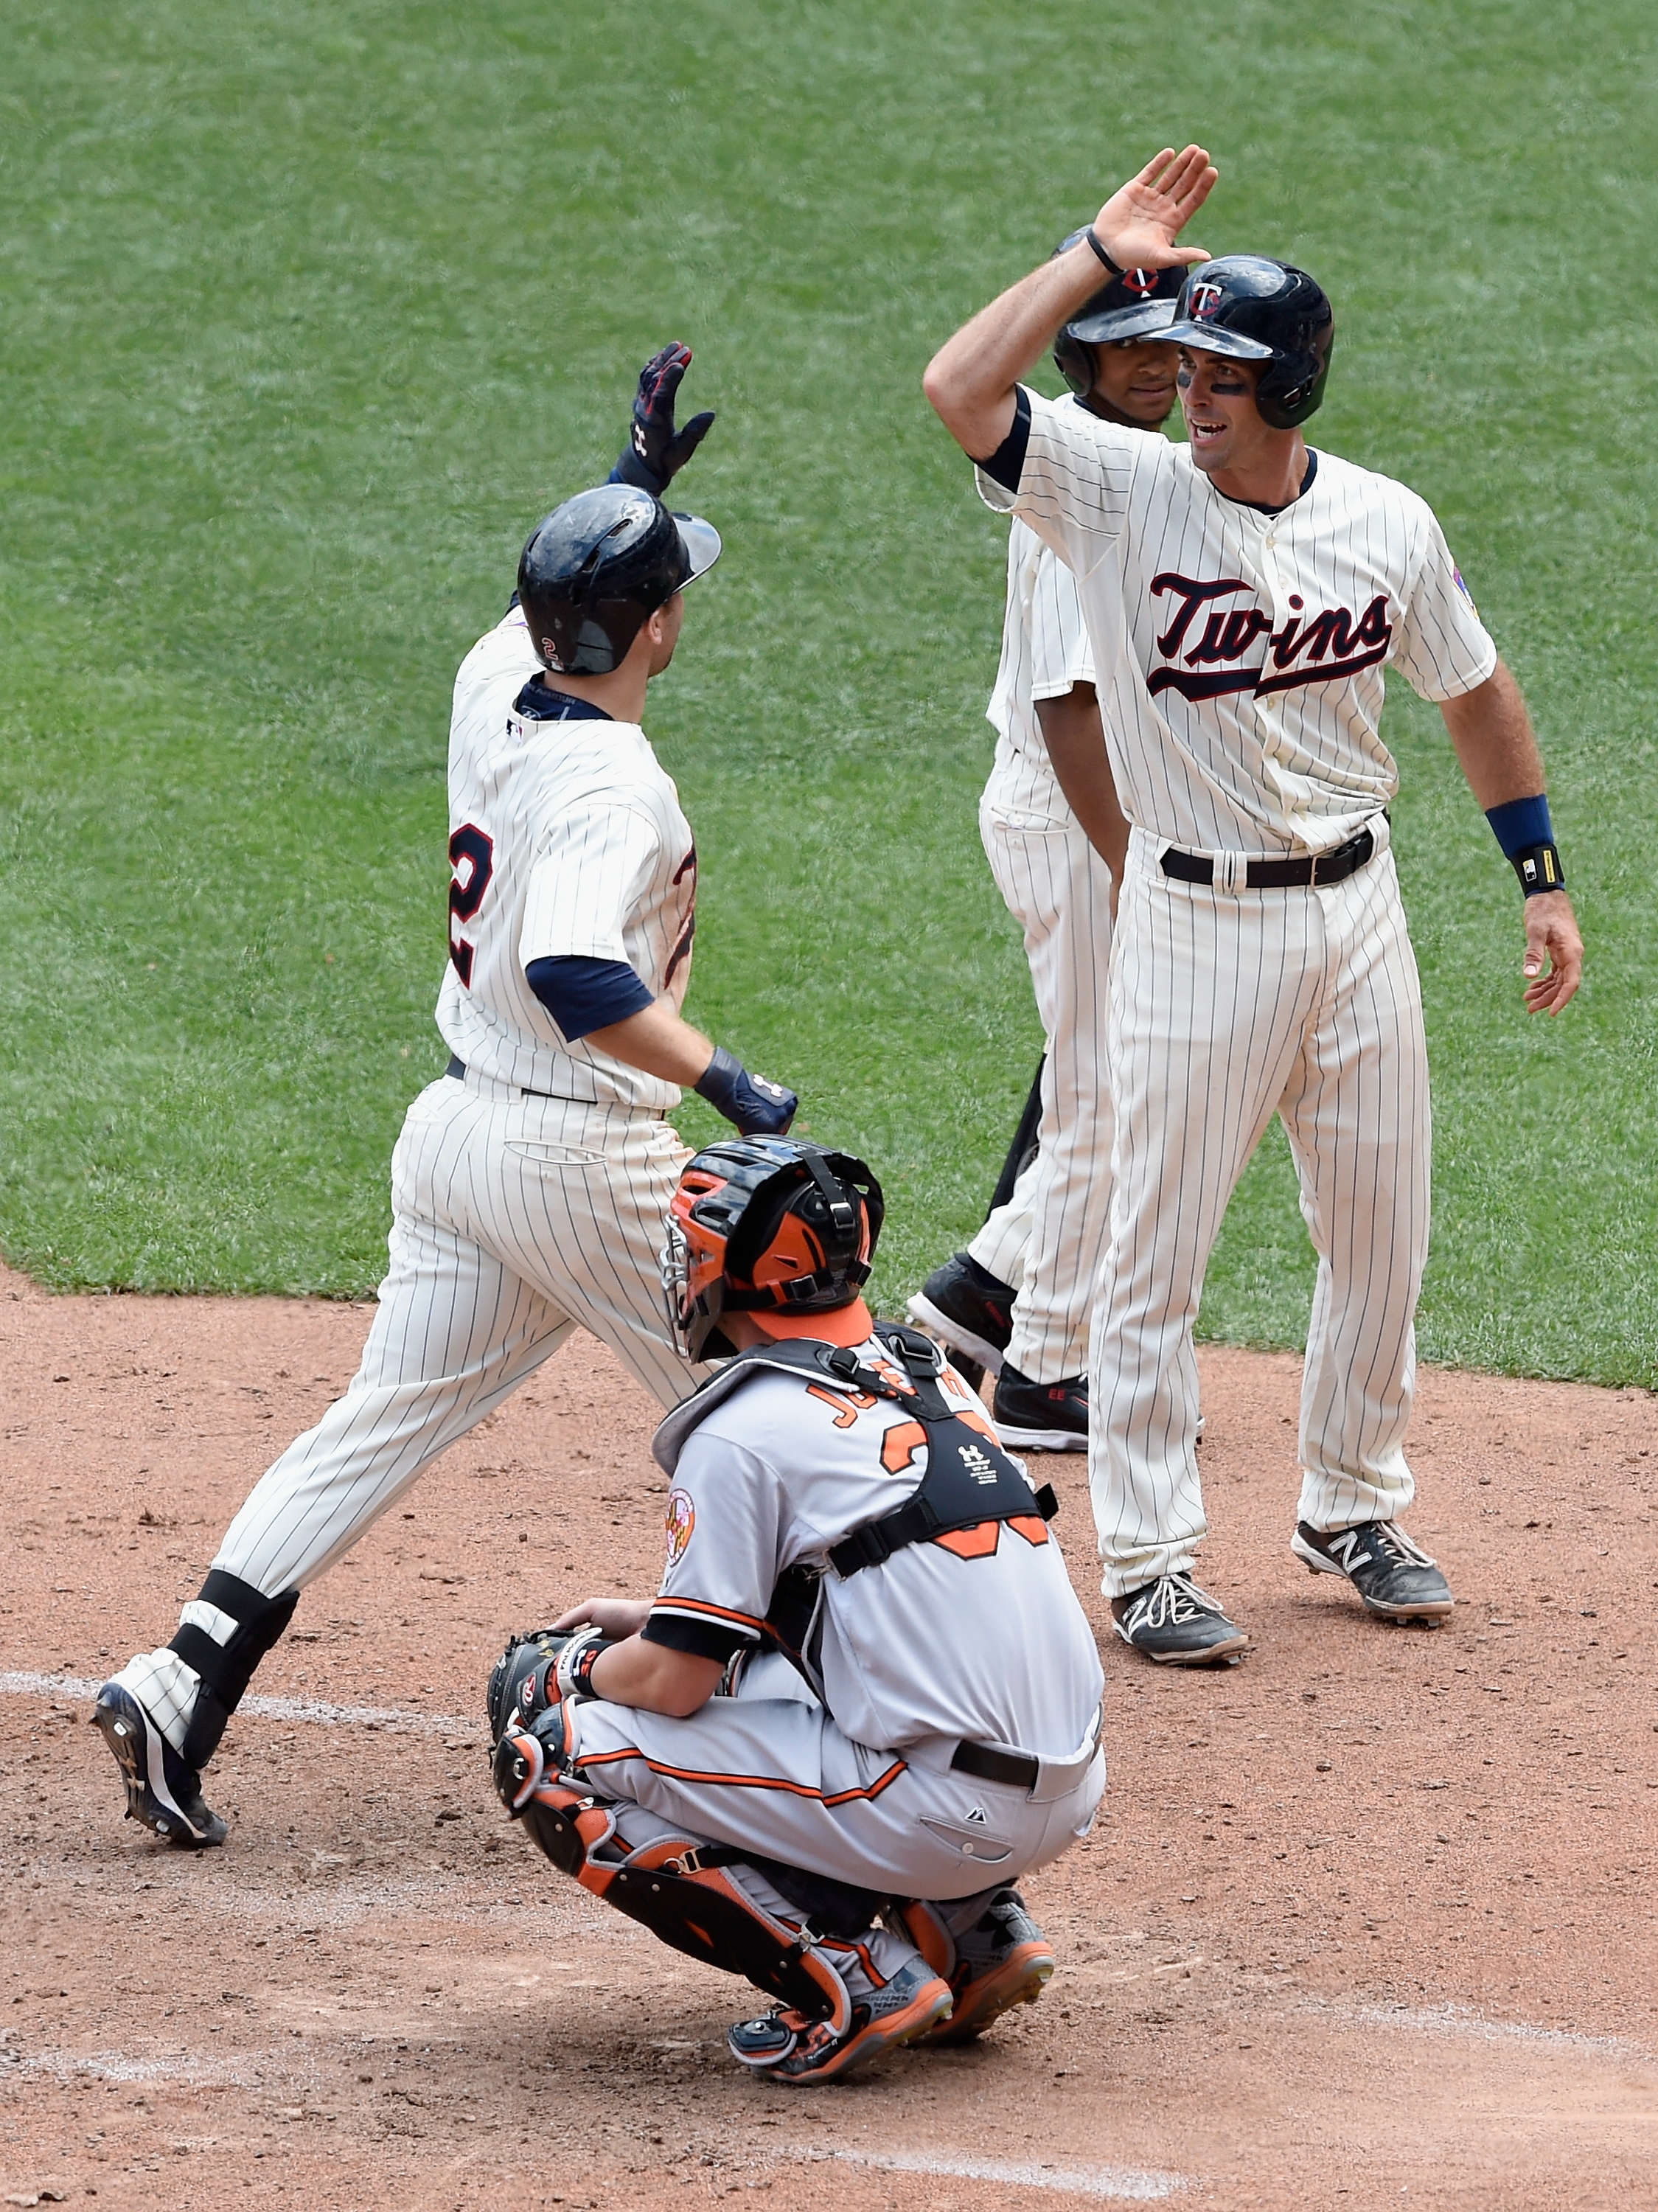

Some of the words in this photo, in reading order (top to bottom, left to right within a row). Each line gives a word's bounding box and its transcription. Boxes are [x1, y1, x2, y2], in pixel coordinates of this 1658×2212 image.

[541, 636, 559, 661] 2
[1149, 572, 1393, 670] Twins
[448, 822, 494, 990] 2
[1048, 1388, 1066, 1402] EE
